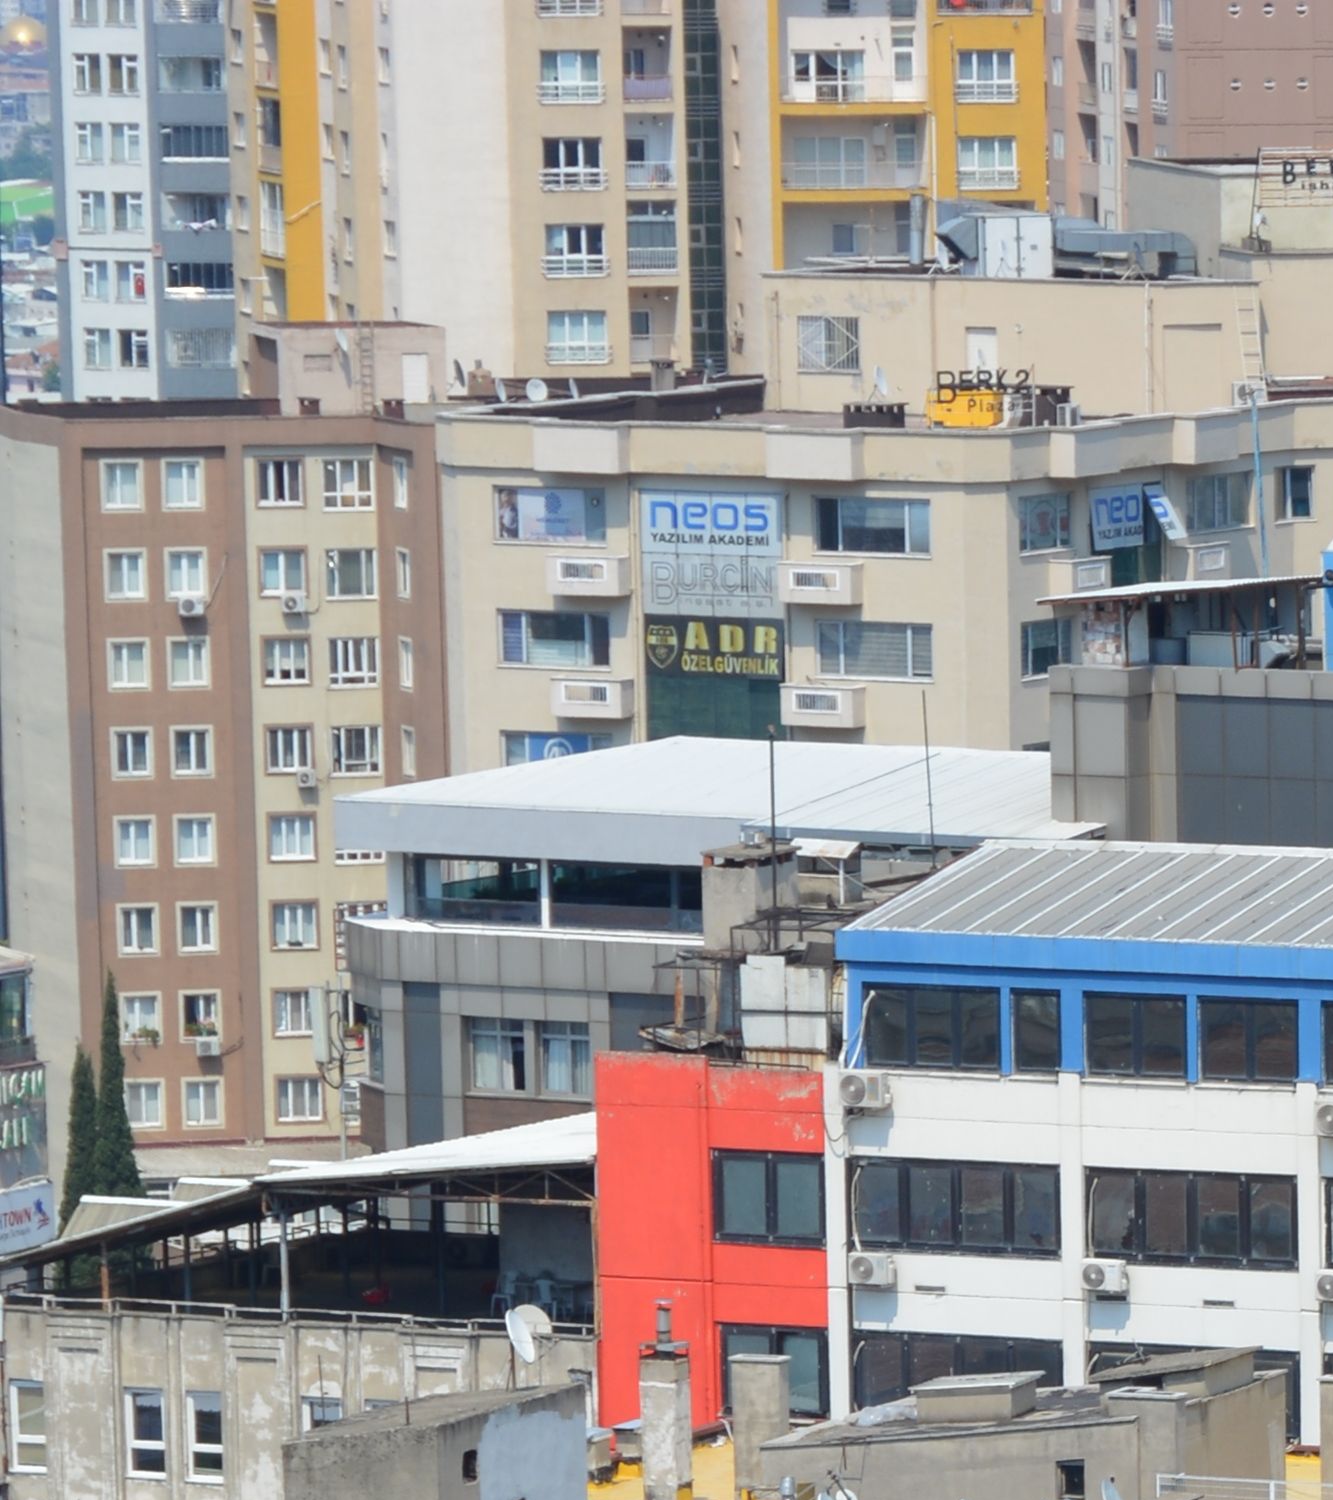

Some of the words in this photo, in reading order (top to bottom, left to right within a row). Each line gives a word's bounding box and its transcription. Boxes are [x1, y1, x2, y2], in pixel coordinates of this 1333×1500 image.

[936, 368, 1008, 404] BERK
[650, 501, 769, 532] neos
[650, 532, 704, 545] YAZILIM
[708, 533, 770, 548] AKADEMİ
[684, 622, 778, 654] ADR
